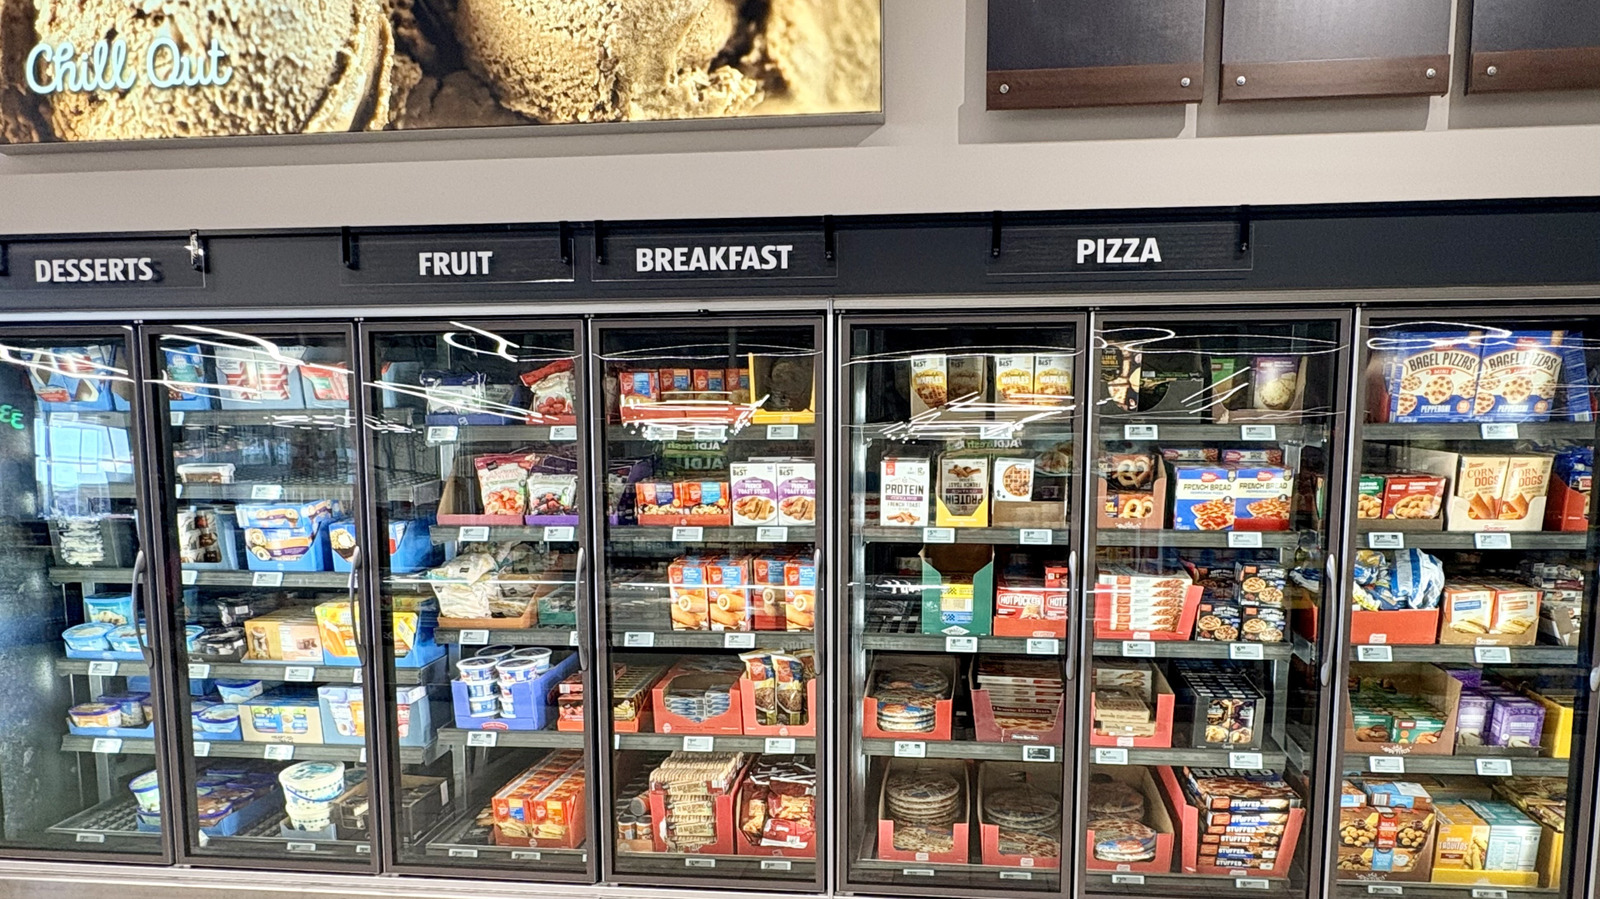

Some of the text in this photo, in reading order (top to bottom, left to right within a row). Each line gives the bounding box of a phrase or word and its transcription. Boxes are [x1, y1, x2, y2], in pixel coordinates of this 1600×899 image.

[26, 37, 233, 94] Chill Out
[1077, 238, 1162, 264] PIZZA
[418, 250, 493, 276] FRUIT
[636, 245, 793, 272] BREAKFAST
[35, 257, 153, 283] DESSERTS
[1408, 352, 1476, 371] BAGEL PIZZAS
[916, 376, 943, 385] WAFFLES
[1001, 376, 1029, 384] WAFFLES
[1040, 376, 1067, 384] WAFFLES
[1420, 405, 1451, 413] PEPPERONI
[1467, 468, 1494, 478] CORN
[1474, 475, 1499, 487] DOGS
[1518, 475, 1543, 487] DOGS
[885, 484, 924, 495] PROTEIN
[946, 495, 983, 505] PROTEIN
[1000, 595, 1013, 604] HOT
[1191, 769, 1274, 777] STUFFED
